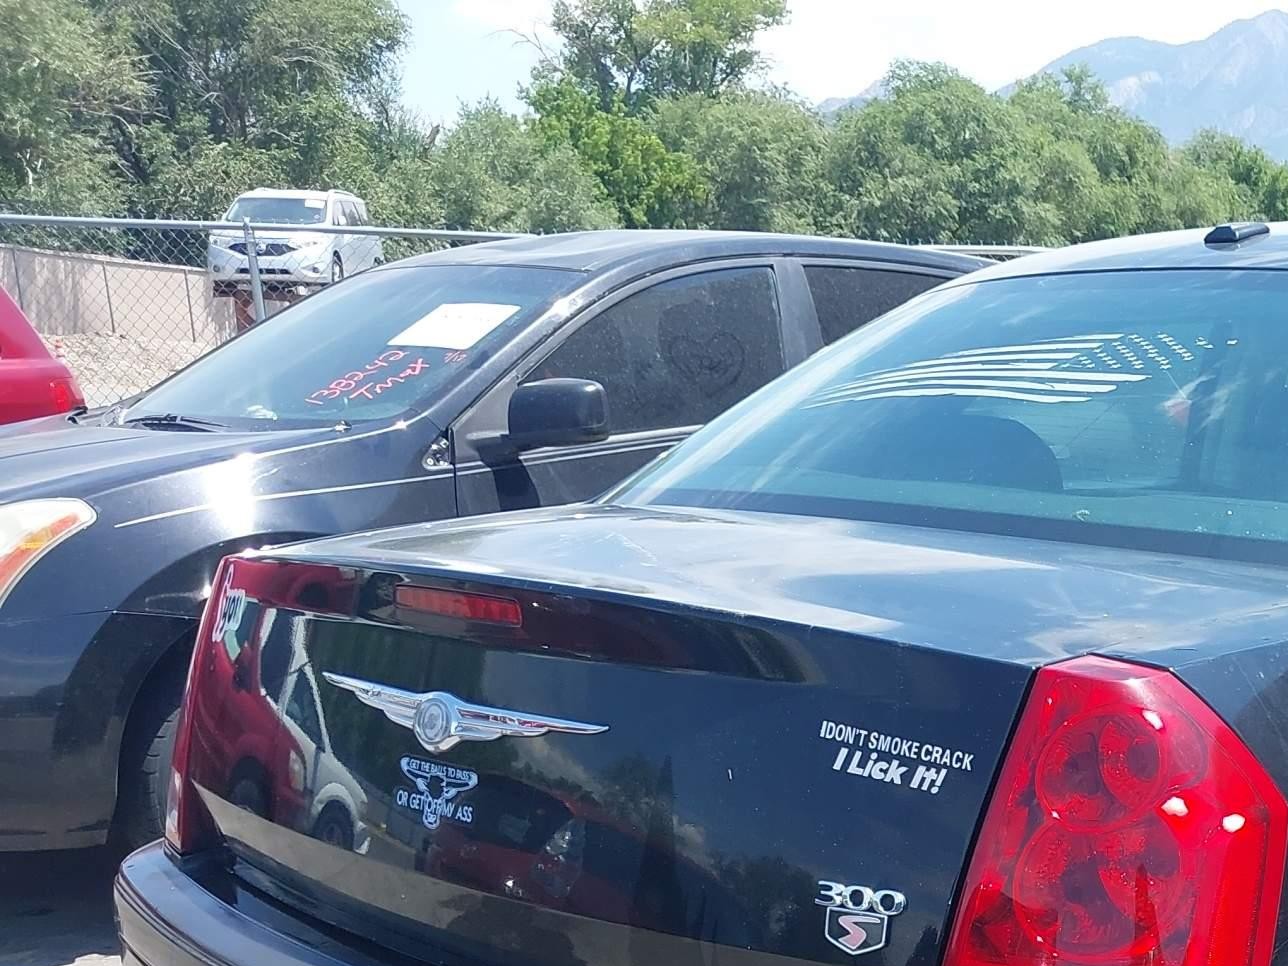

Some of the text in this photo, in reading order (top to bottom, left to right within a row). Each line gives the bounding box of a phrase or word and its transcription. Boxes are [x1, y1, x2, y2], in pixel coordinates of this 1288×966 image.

[409, 758, 420, 770] GET
[447, 767, 455, 778] TO
[868, 731, 920, 759] SMOKE
[920, 744, 975, 771] CRACK
[832, 746, 948, 795] I Lick It!
[397, 789, 408, 807] OR
[409, 793, 424, 811] GET
[441, 799, 455, 817] MY
[455, 806, 473, 823] ASS
[814, 880, 907, 916] 300
